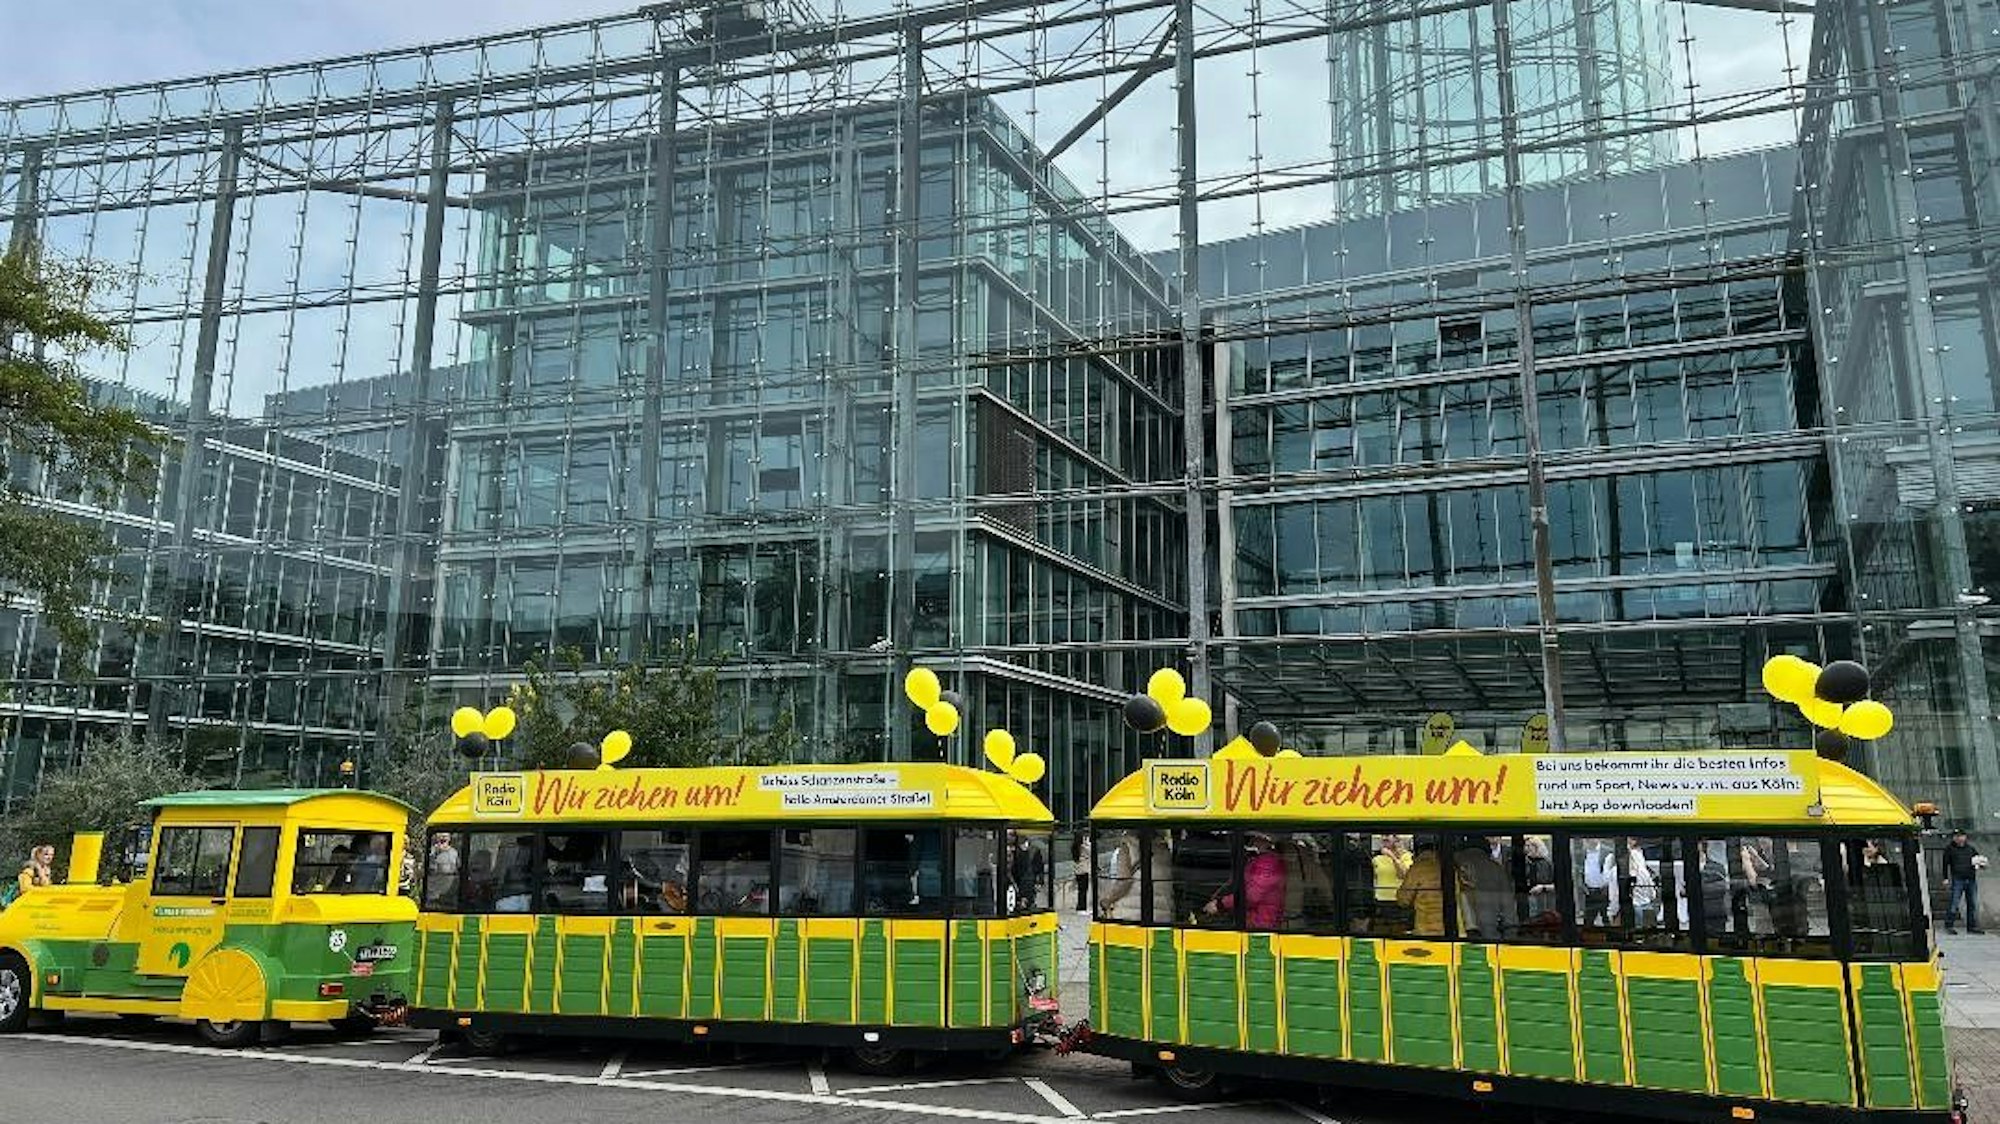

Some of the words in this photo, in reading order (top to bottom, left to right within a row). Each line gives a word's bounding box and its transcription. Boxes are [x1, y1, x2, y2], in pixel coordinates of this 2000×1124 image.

[1536, 760, 1556, 771] Bei
[1560, 761, 1582, 771] uns
[1584, 759, 1648, 771] bekommt
[1651, 758, 1668, 769] ihr
[1673, 758, 1695, 769] die
[1699, 757, 1745, 769] besten
[1749, 757, 1786, 769] Infos
[761, 775, 799, 786] Tschüss
[801, 773, 886, 786] Schanzenstraße
[1160, 773, 1199, 786] Radio
[1225, 759, 1292, 811] Wir
[1304, 765, 1414, 808] ziehen
[1425, 764, 1508, 805] um!
[1538, 780, 1567, 791] rund
[1571, 782, 1592, 790] um
[1595, 779, 1635, 792] Sport,
[1638, 780, 1679, 790] News
[1732, 781, 1758, 790] aus
[484, 783, 516, 795] Radio
[533, 771, 590, 816] Wir
[594, 776, 678, 812] ziehen
[684, 775, 746, 807] um!
[1164, 788, 1196, 801] Köln
[486, 796, 512, 807] Köln
[1540, 800, 1569, 811] Jetzt
[1572, 801, 1599, 813] App
[1603, 800, 1693, 811] downloaden!
